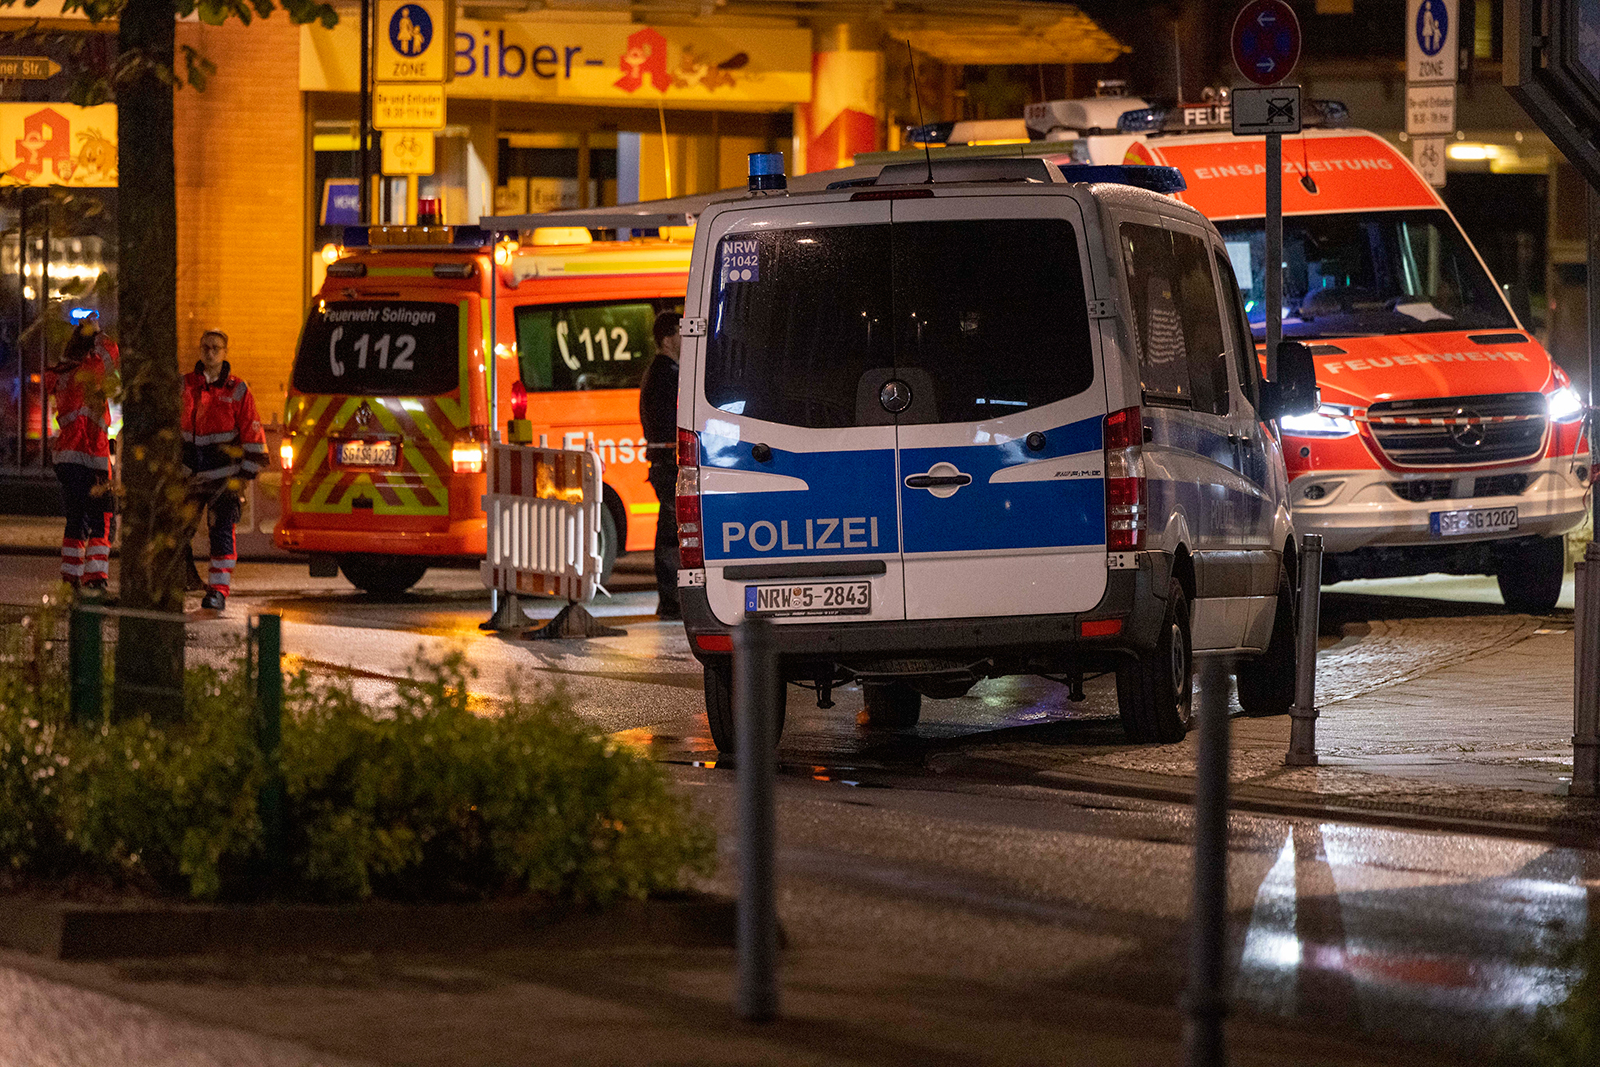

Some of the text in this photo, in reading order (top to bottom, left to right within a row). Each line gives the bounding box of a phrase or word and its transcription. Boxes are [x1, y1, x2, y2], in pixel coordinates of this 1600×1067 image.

[455, 29, 604, 78] Biber-
[0, 62, 17, 75] ner
[393, 62, 427, 76] ZONE
[1419, 60, 1443, 77] ZONE
[1184, 107, 1232, 125] FEUE
[1194, 158, 1394, 180] EINSAZLEITUNG
[723, 241, 757, 254] NRW
[723, 255, 758, 267] 21042
[323, 302, 436, 326] Feuerwehr Solingen
[354, 332, 417, 371] 112
[579, 326, 632, 361] 112
[1323, 351, 1530, 375] FEUERWEHR
[564, 431, 648, 464] Ensa
[1486, 510, 1516, 527] 1202
[722, 516, 879, 553] POLIZEI
[758, 588, 792, 609] NRW
[803, 585, 868, 608] 5-2843
